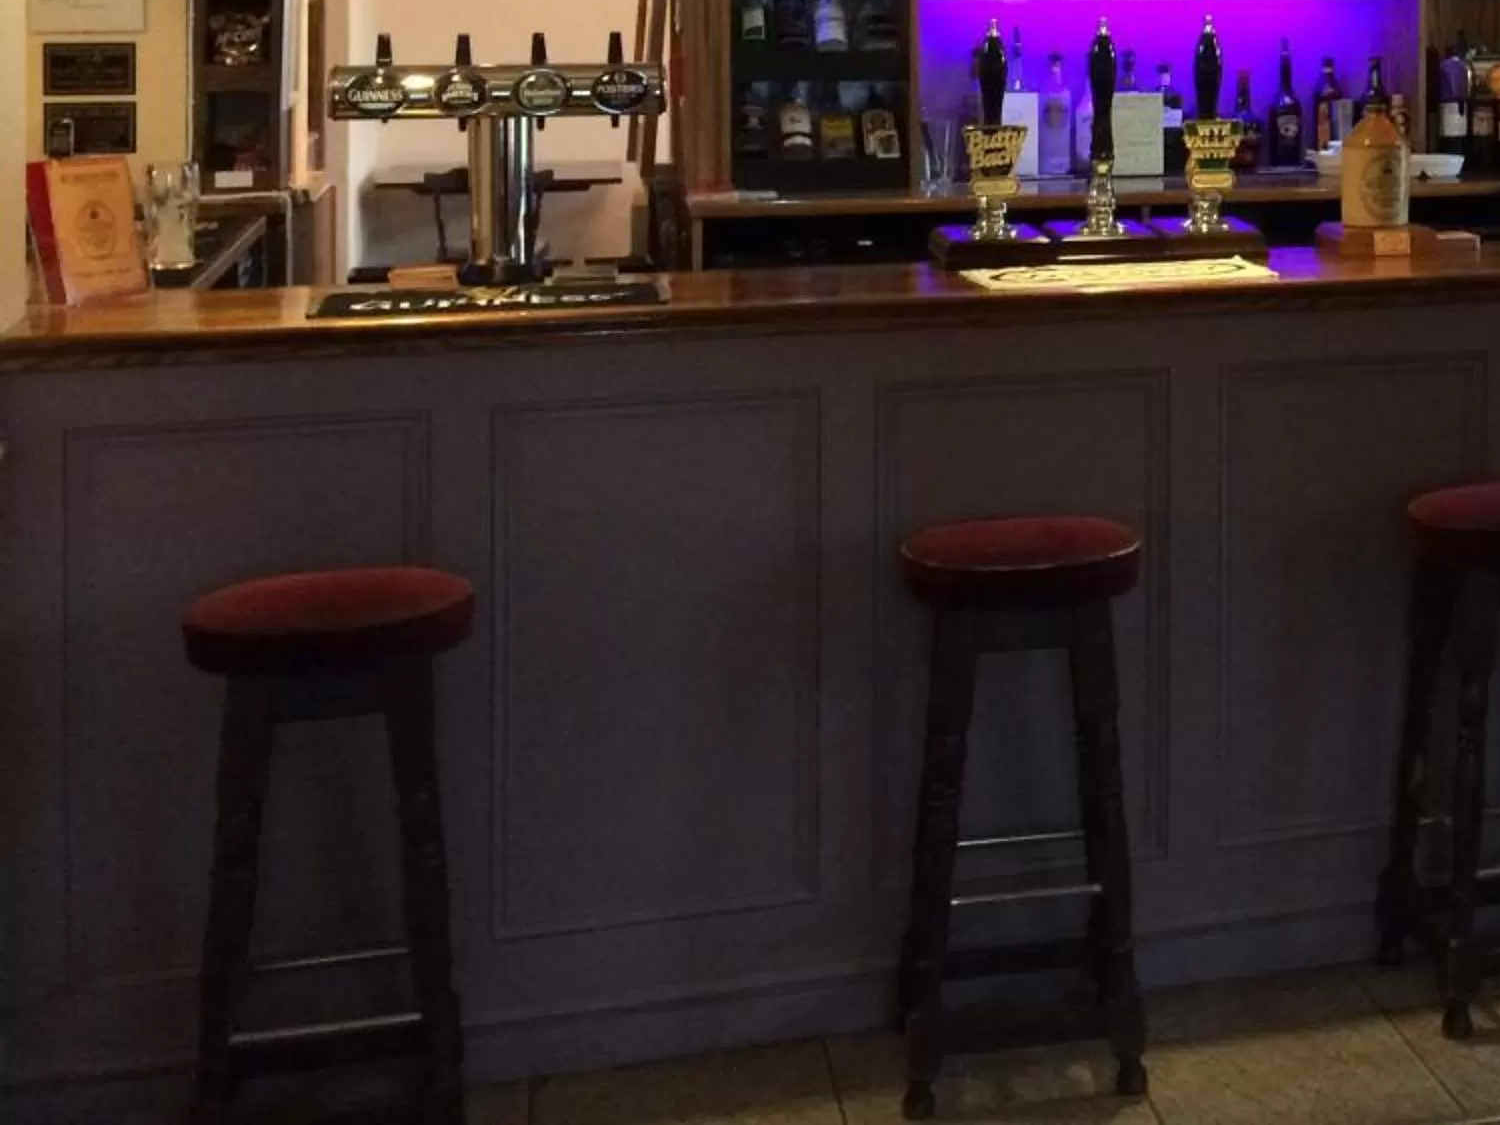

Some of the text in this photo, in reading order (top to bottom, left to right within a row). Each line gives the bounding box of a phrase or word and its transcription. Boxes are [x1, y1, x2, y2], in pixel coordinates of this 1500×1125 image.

[347, 88, 403, 102] GUINNESS
[963, 129, 1024, 152] Butty
[969, 149, 1016, 169] Bach
